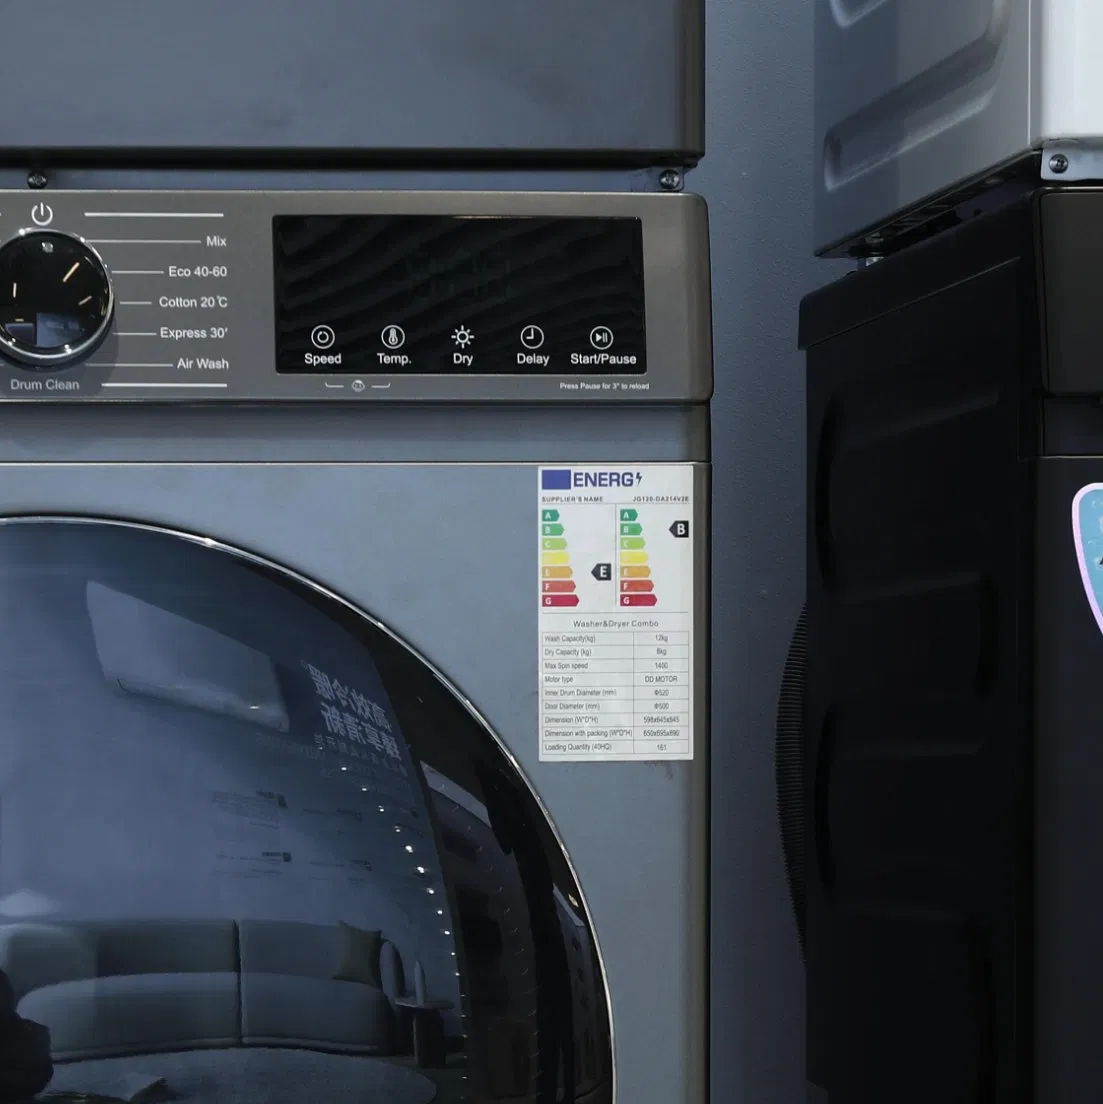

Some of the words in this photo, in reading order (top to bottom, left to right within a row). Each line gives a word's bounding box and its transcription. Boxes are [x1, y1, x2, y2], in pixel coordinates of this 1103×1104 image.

[206, 235, 227, 248] Mix
[168, 266, 191, 278] Eco
[194, 266, 227, 278] 40-60
[159, 296, 197, 309] Cotton
[160, 327, 207, 341] Express
[177, 358, 193, 370] Air
[196, 358, 229, 370] Wash
[304, 353, 342, 367] Speed
[376, 353, 412, 367] Temp.
[453, 353, 474, 367] Dry
[516, 353, 550, 367] Delay
[570, 352, 637, 367] Start/Pause
[10, 378, 42, 391] Drum
[45, 378, 80, 391] Clean
[559, 382, 578, 390] Press
[580, 382, 601, 390] Pause
[602, 382, 611, 390] for
[621, 382, 628, 390] to
[629, 382, 650, 390] reload
[573, 472, 634, 487] ENERG
[623, 511, 630, 519] A
[677, 523, 686, 535] B
[599, 566, 608, 578] E
[544, 583, 551, 591] F
[623, 582, 629, 590] F
[544, 597, 552, 605] G
[573, 620, 630, 628] Washer&Dryer
[631, 620, 659, 628] Combo
[556, 648, 580, 657] Capacity
[558, 662, 571, 670] Spin
[571, 662, 588, 670] speed
[561, 676, 574, 684] type
[655, 675, 678, 683] MOTOR
[559, 702, 584, 710] Diameter
[587, 730, 608, 738] packing
[544, 743, 567, 751] Loading
[568, 743, 591, 751] Quantity
